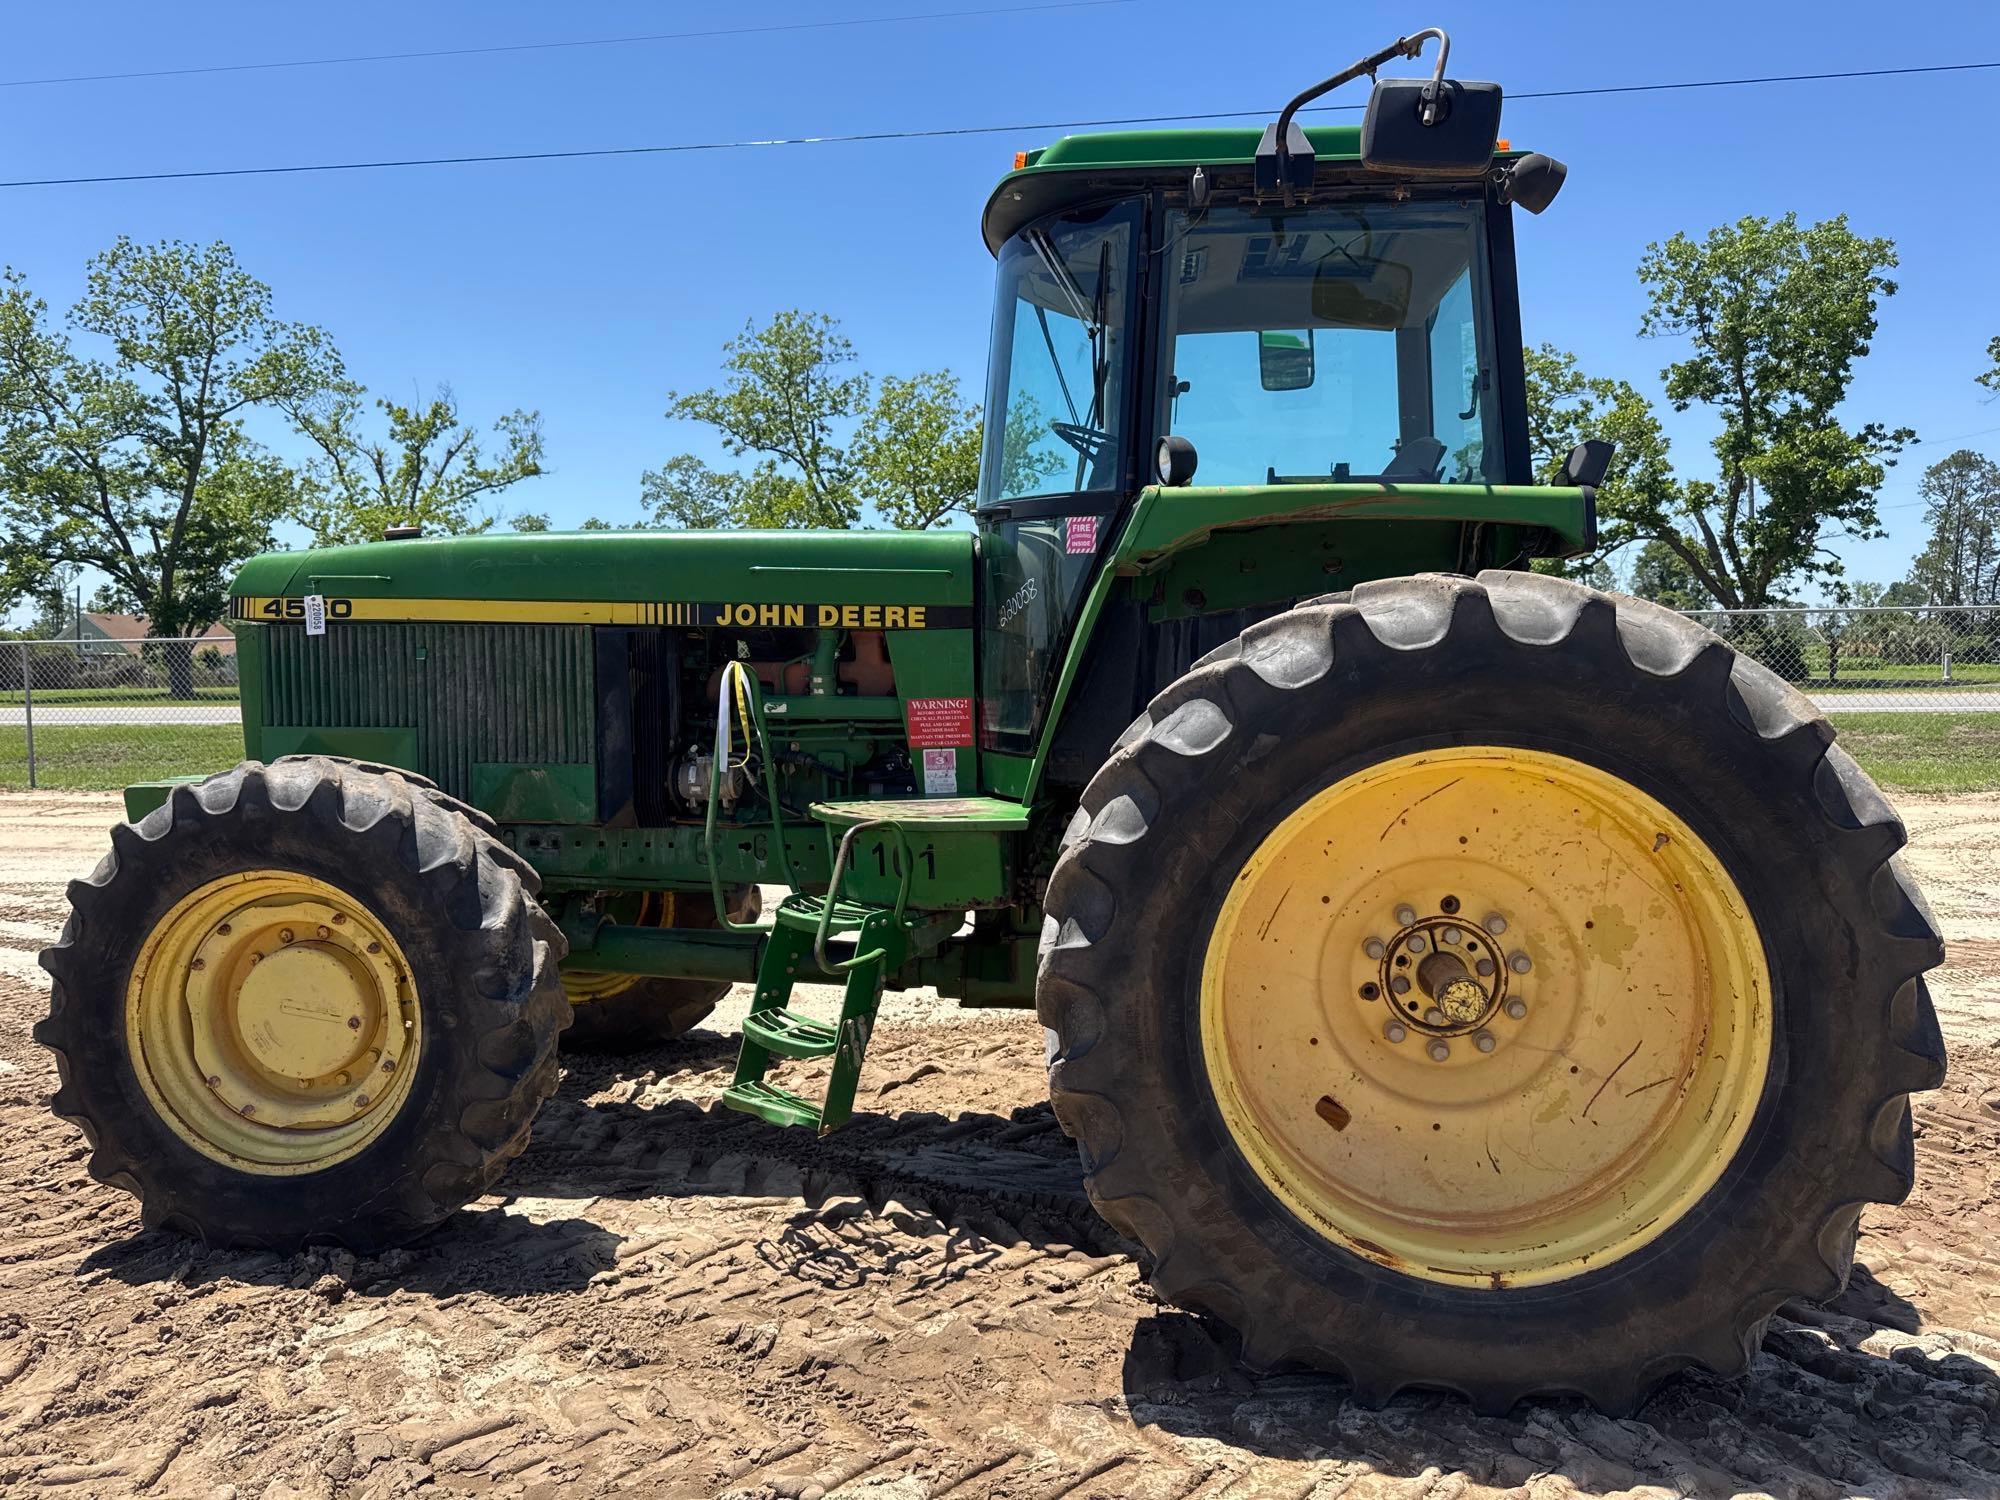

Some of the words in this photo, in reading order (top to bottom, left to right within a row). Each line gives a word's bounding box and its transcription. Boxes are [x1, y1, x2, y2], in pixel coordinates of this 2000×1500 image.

[1072, 524, 1091, 532] FIRE
[263, 599, 352, 618] 450
[716, 603, 804, 626] JOHN
[818, 604, 926, 628] DEERE
[312, 602, 322, 630] 220058
[911, 699, 968, 709] WARNING!
[936, 757, 945, 765] 3
